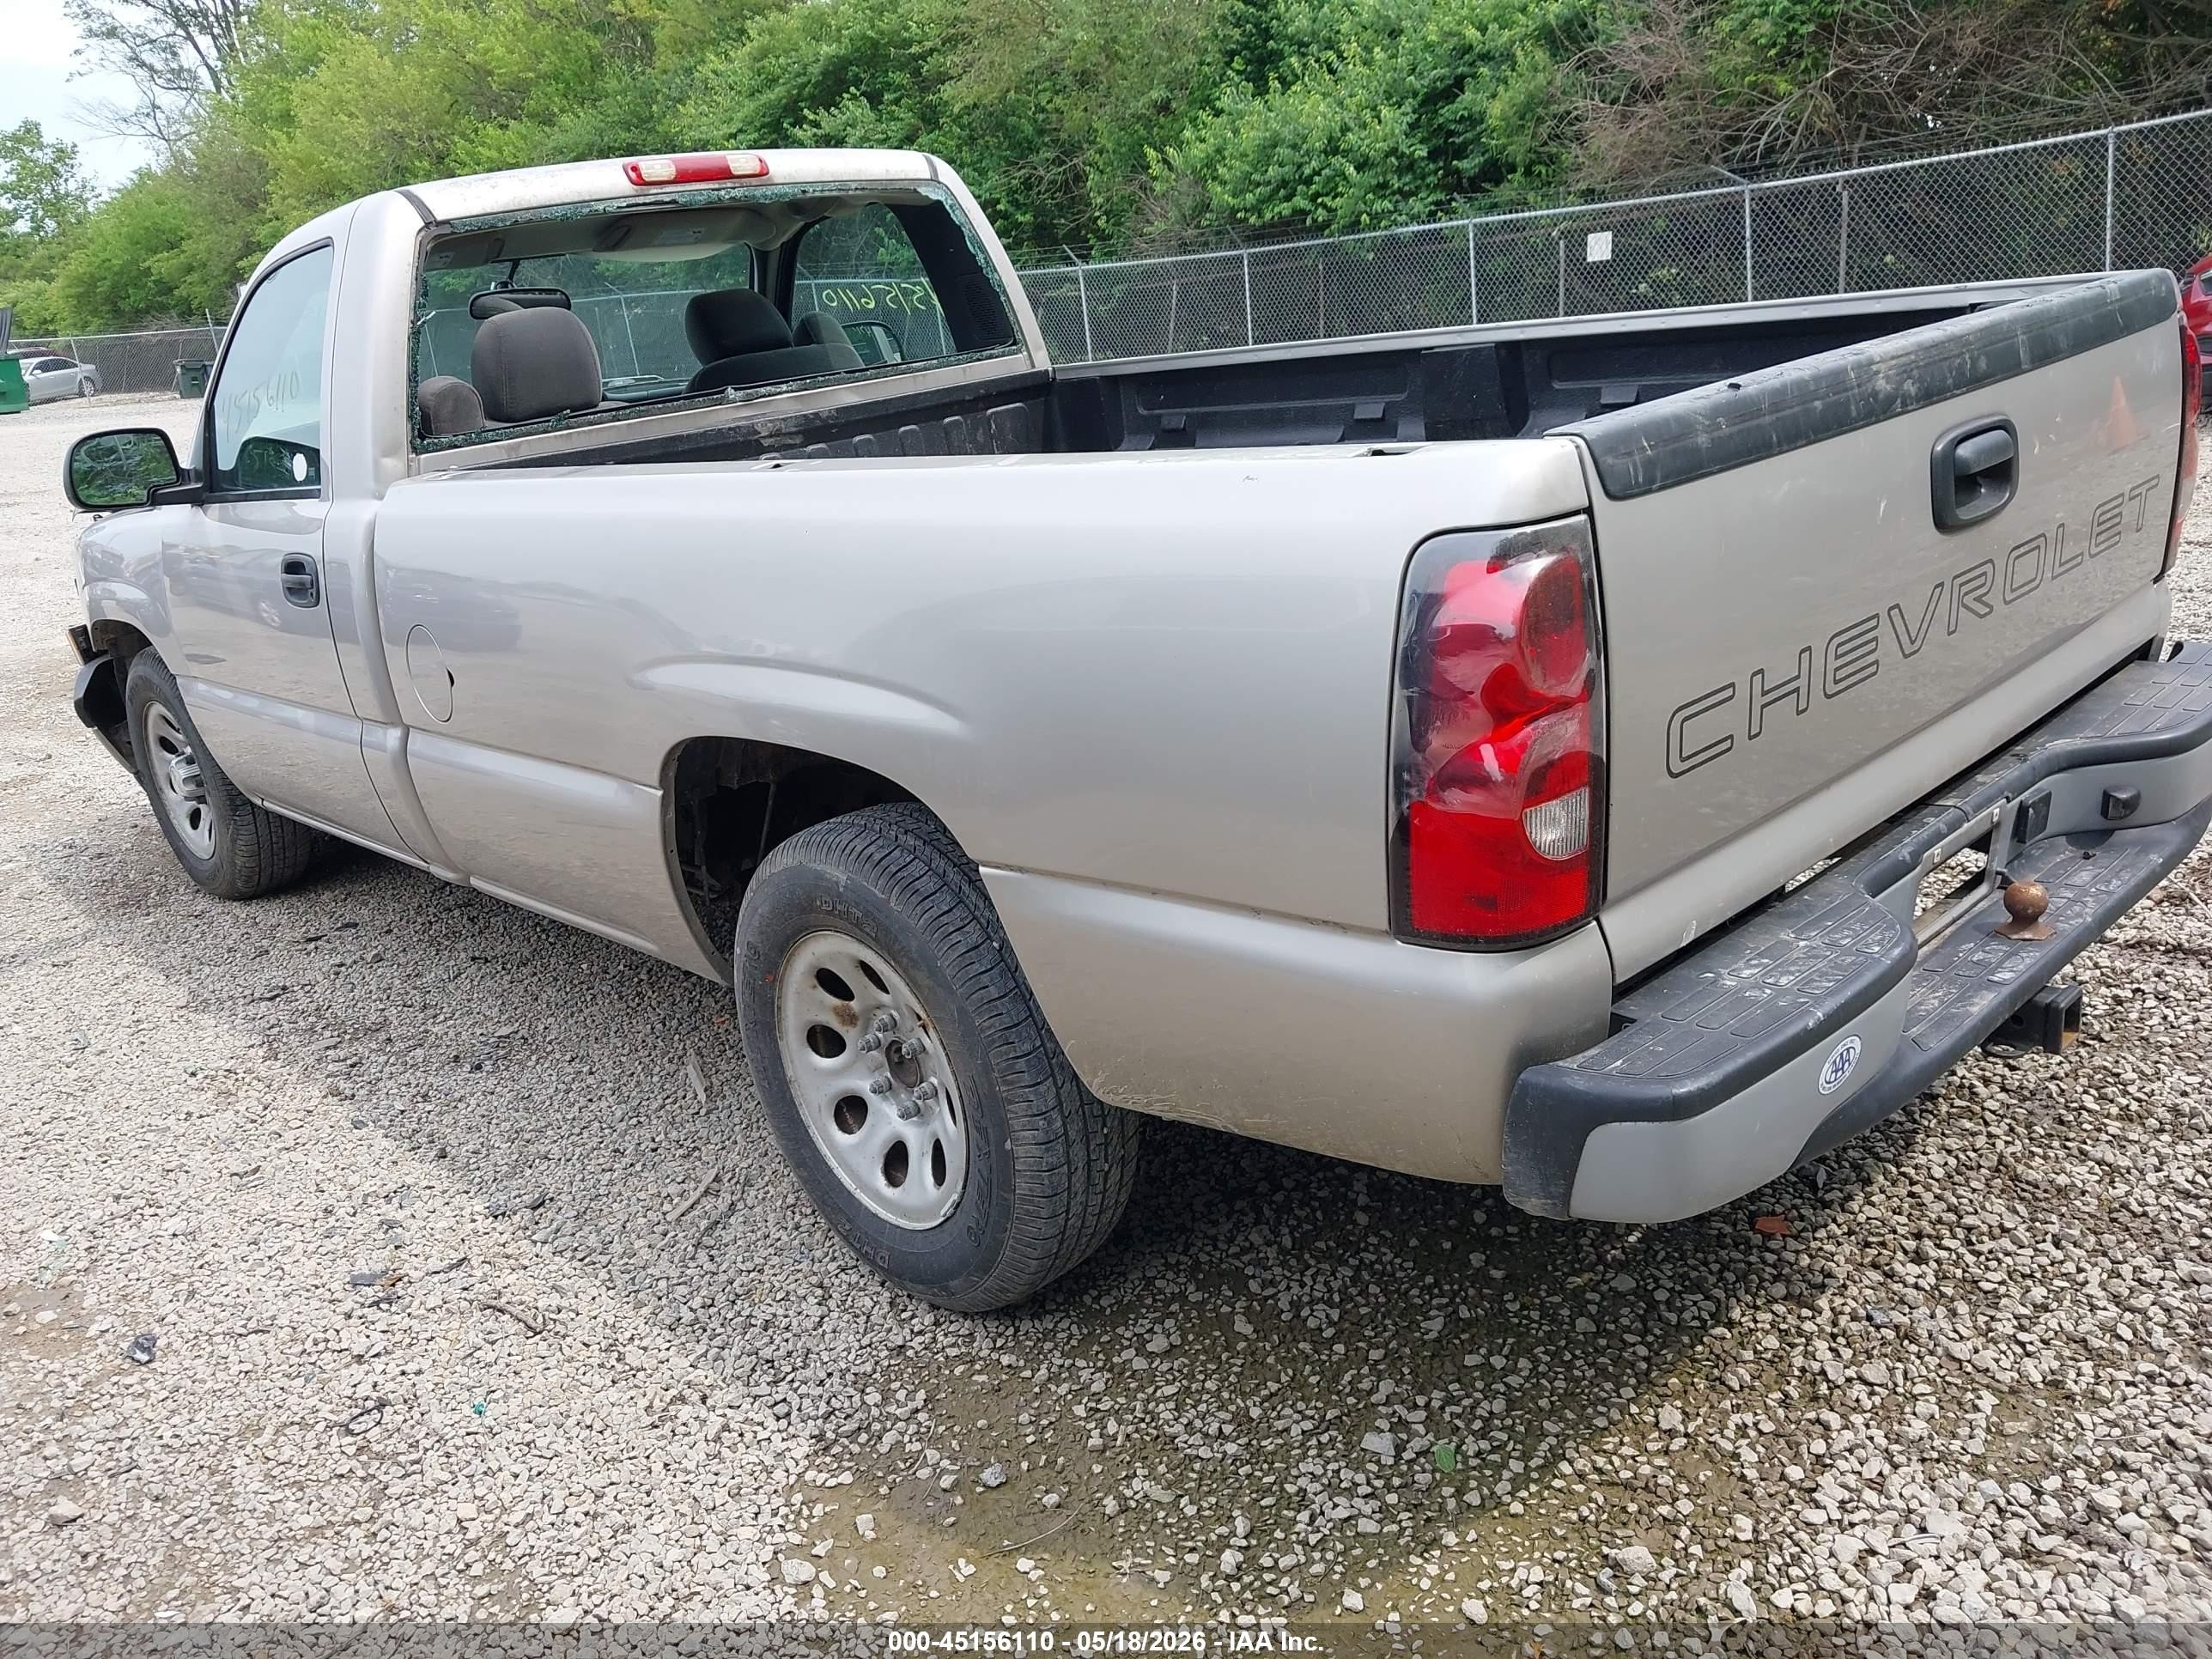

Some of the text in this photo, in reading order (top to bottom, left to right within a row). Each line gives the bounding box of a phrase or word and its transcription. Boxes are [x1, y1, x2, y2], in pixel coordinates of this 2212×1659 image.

[221, 369, 301, 444] 45156110
[1666, 473, 2161, 780] CHEVROLET
[1827, 1047, 1853, 1084] AAA
